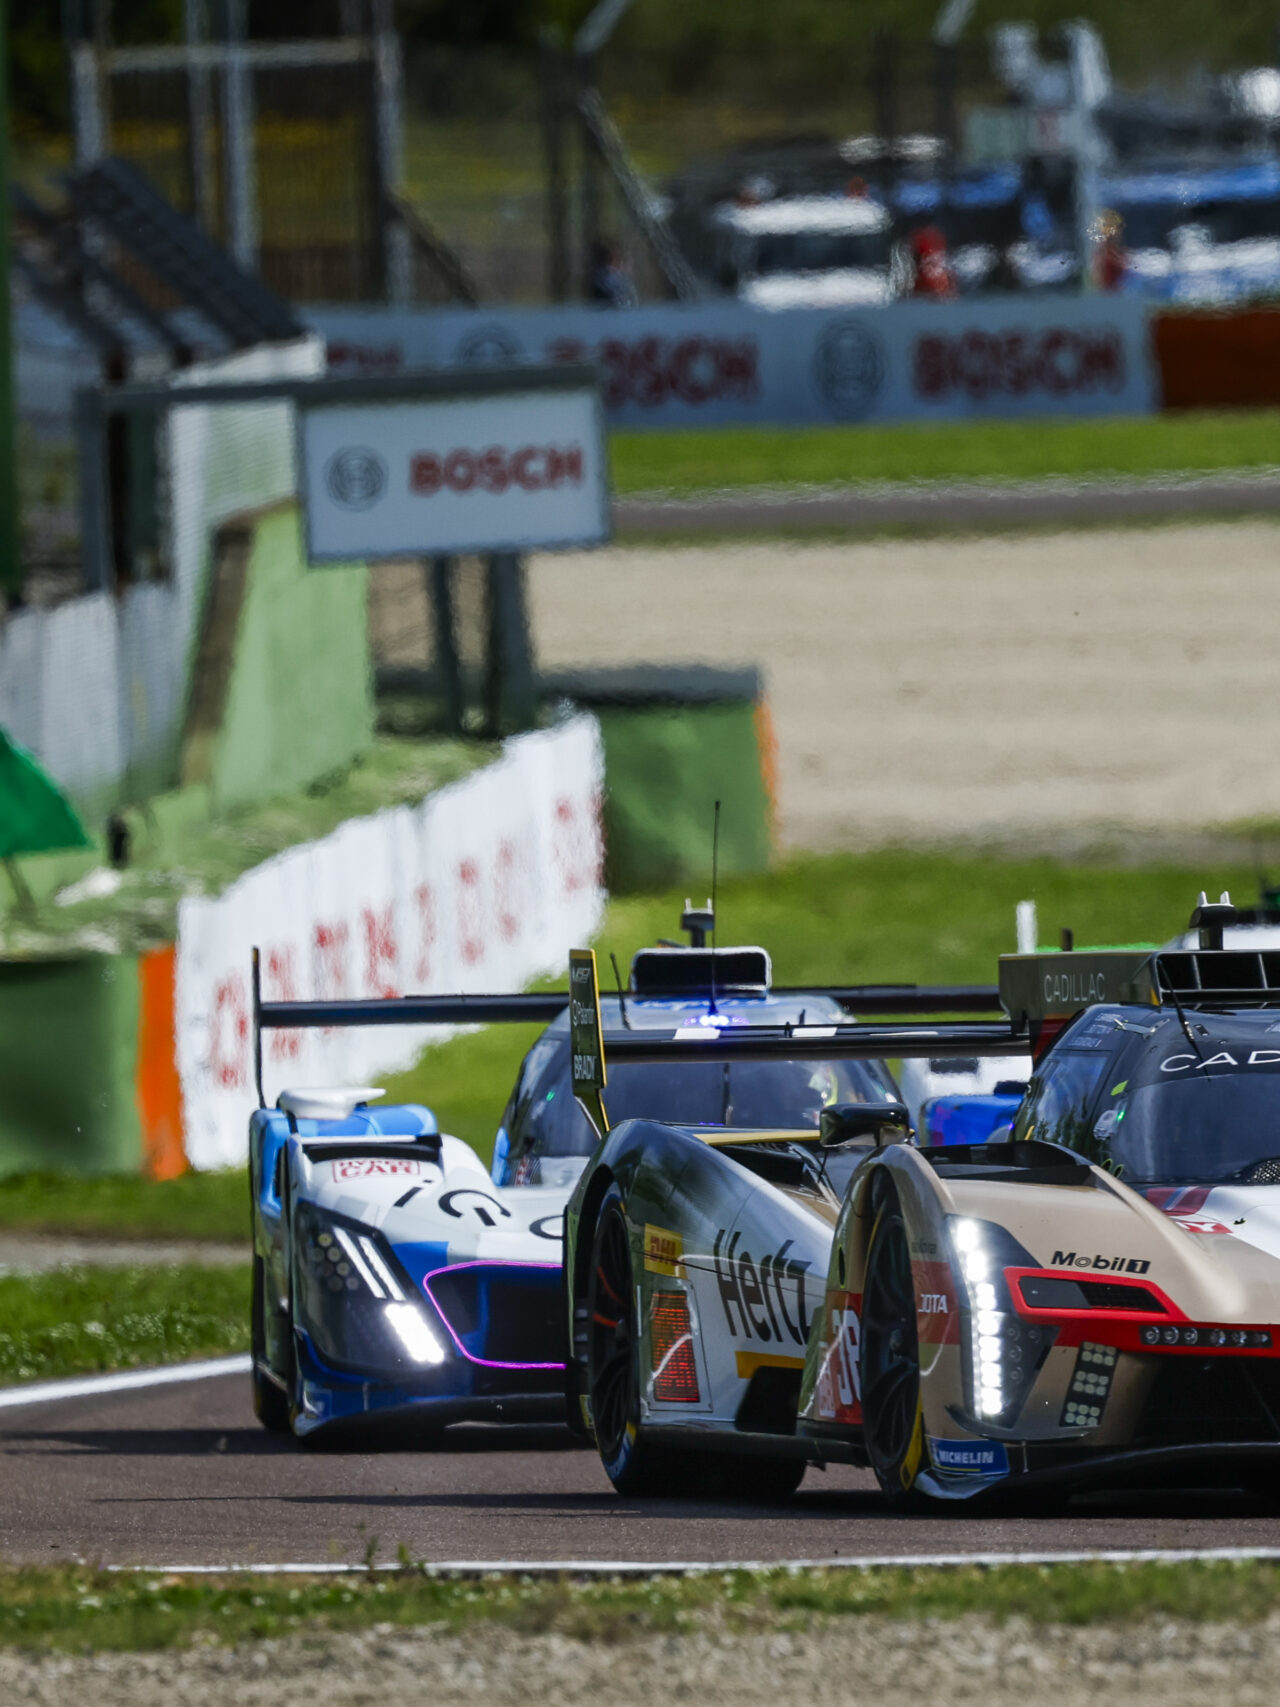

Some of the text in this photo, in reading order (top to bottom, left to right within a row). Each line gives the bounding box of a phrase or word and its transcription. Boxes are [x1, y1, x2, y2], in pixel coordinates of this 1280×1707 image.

[911, 327, 1124, 398] BOSCH
[410, 445, 584, 496] BOSCH
[1044, 973, 1105, 1002] CADILLAC
[713, 1229, 813, 1345] Hertz
[918, 1294, 948, 1313] JOTA
[938, 1450, 995, 1464] MICHELIN
